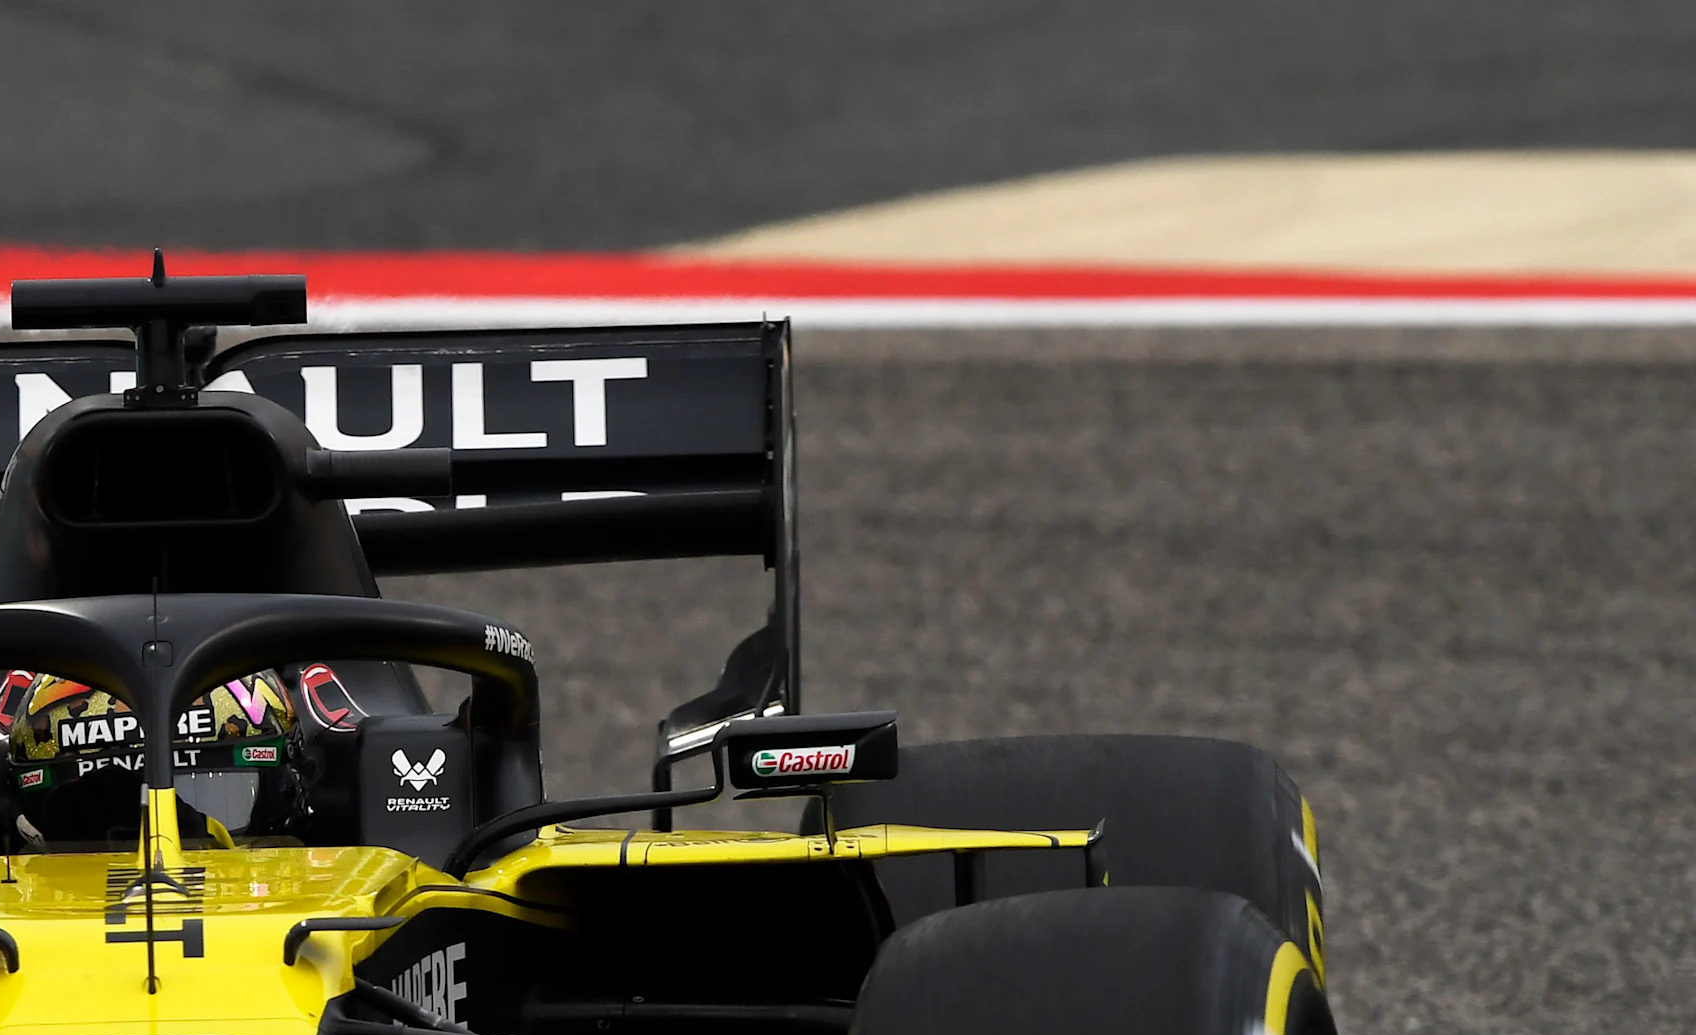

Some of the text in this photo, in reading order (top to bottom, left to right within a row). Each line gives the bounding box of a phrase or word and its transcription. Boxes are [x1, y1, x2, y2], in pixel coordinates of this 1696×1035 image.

[61, 709, 212, 747] MAPRE
[779, 749, 849, 773] Castrol
[386, 803, 451, 812] VITALITY
[387, 797, 450, 806] RENAULT
